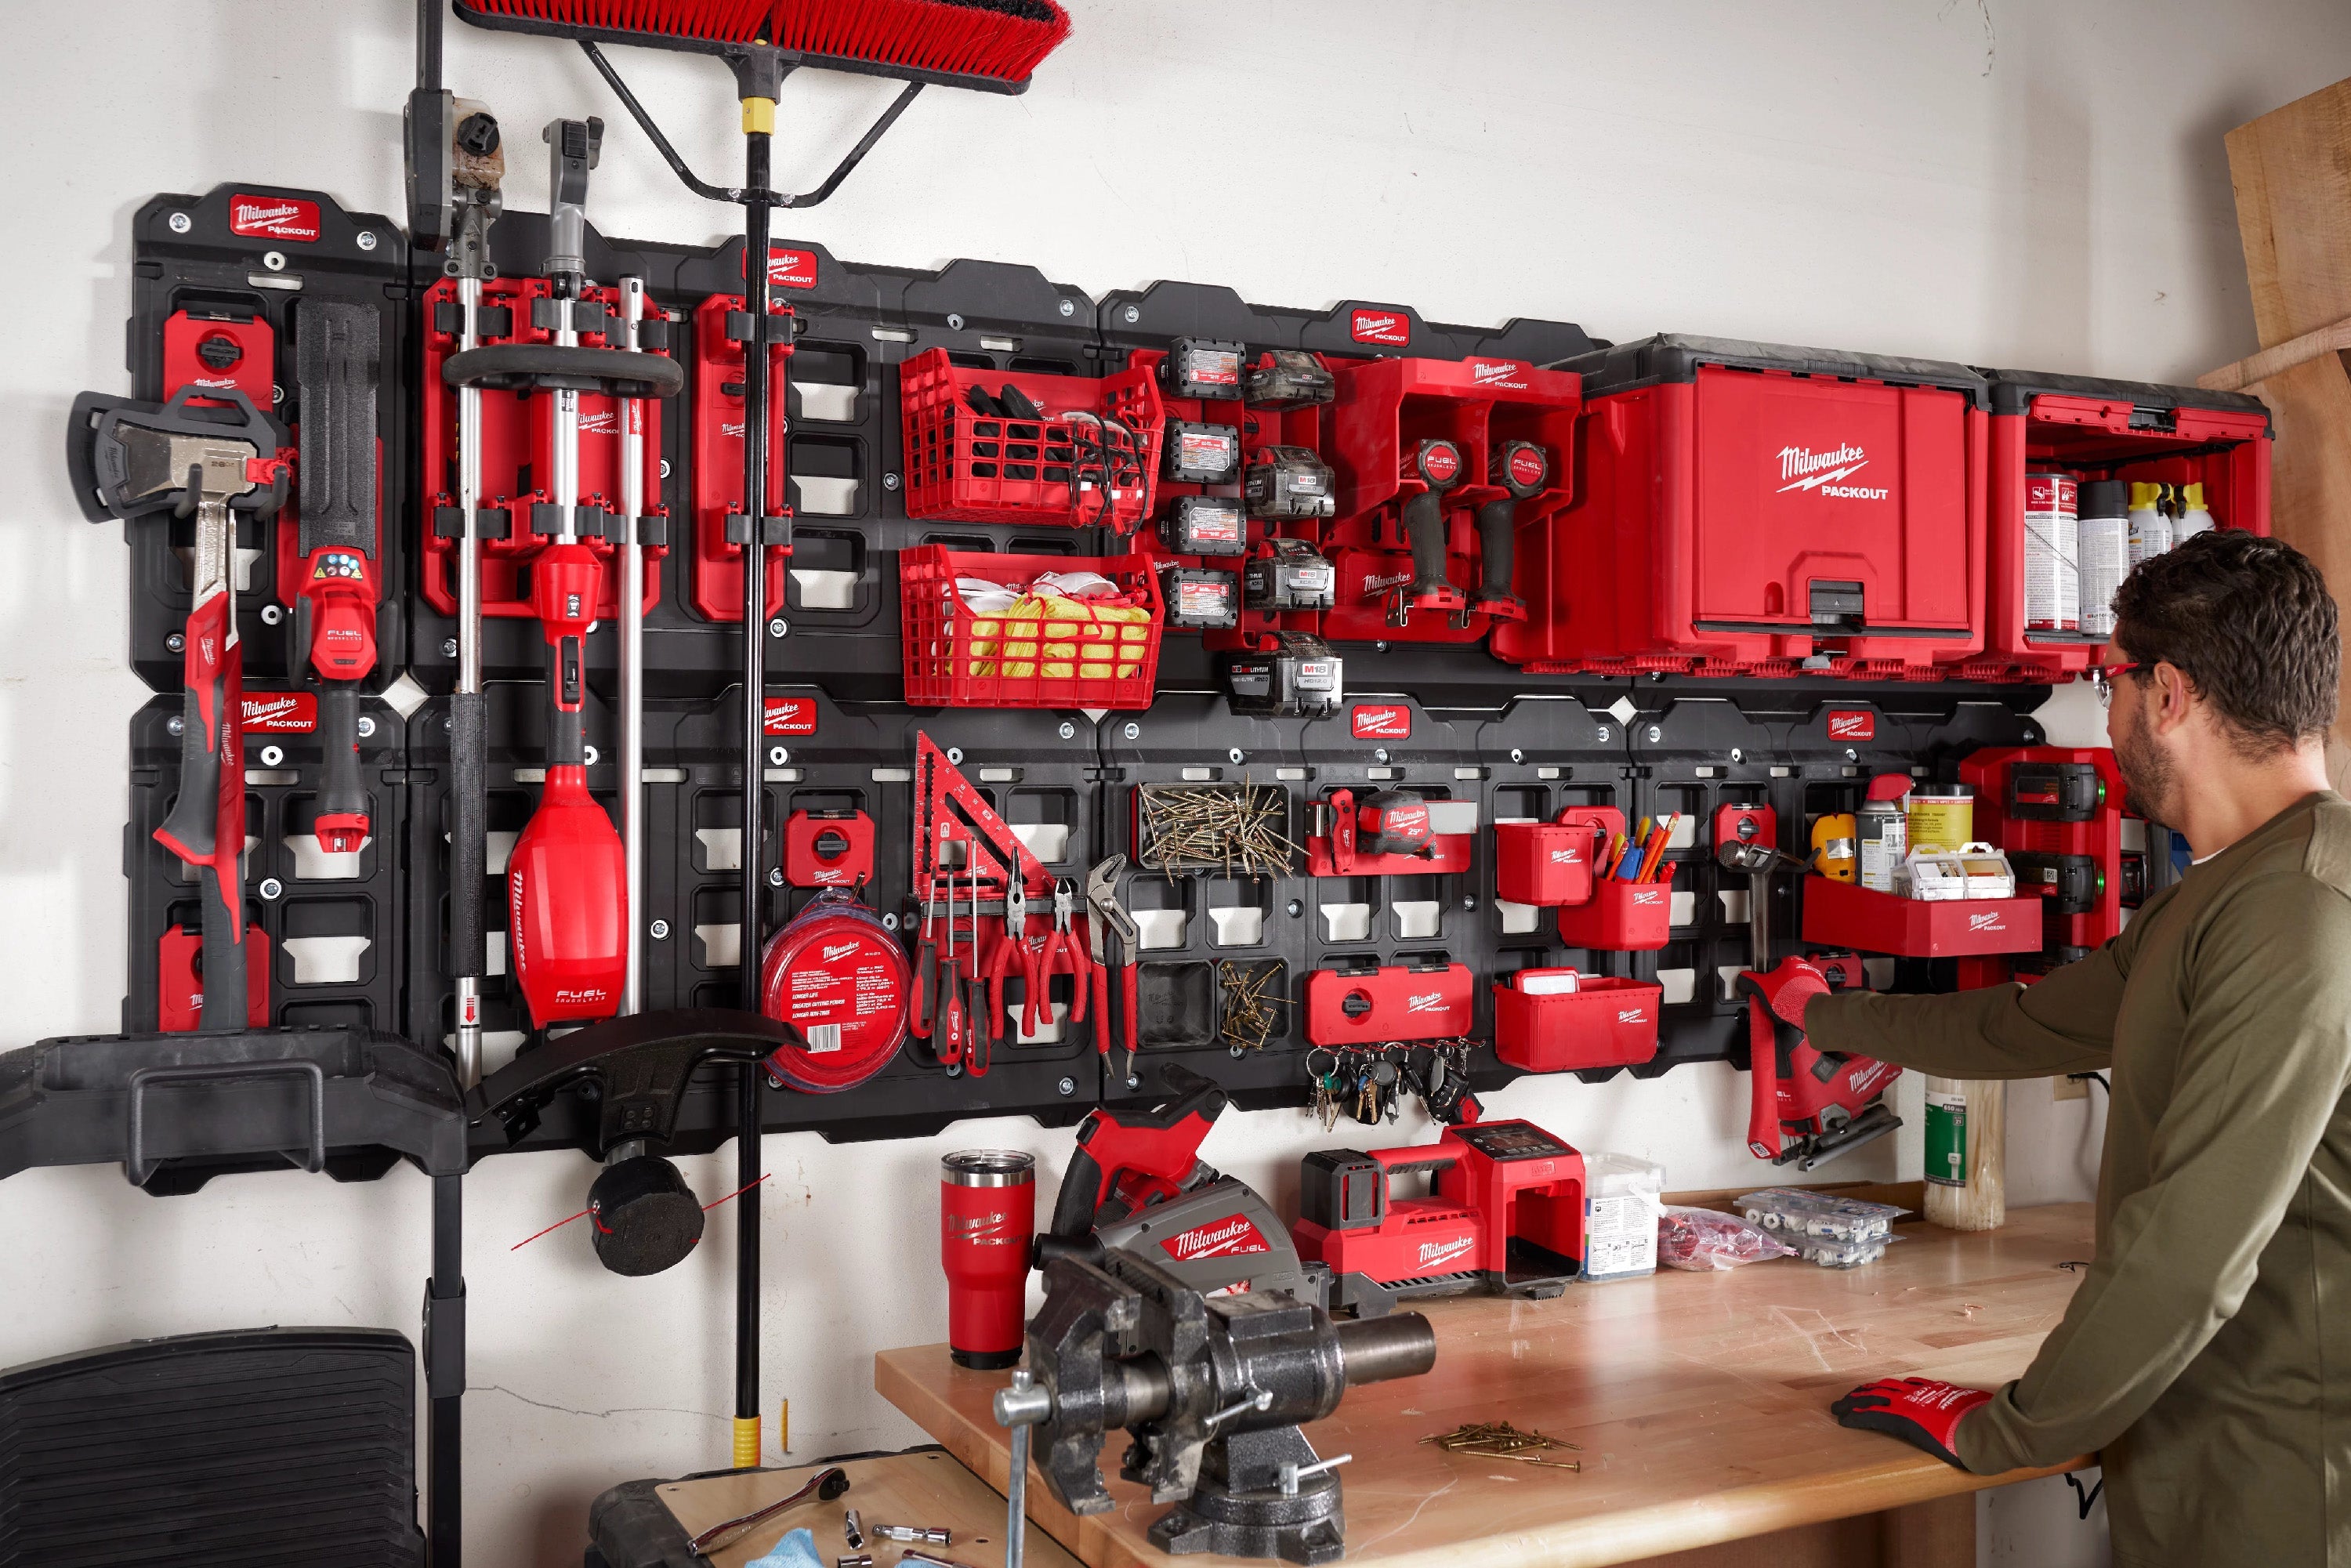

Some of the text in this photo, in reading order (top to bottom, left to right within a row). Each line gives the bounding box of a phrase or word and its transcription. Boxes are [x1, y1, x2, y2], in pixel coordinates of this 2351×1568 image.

[235, 204, 299, 223] Milwaukee
[268, 226, 316, 237] PACKOUT
[773, 273, 813, 284] PACKOUT
[1355, 316, 1396, 331] Milwaukee
[1375, 334, 1407, 342] PACKOUT
[1474, 362, 1517, 379] Milwaukee
[194, 378, 236, 388] Milwaukee
[1494, 381, 1528, 390] PACKOUT
[578, 411, 614, 424] ilwaukee
[1427, 455, 1456, 465] FUEL
[1513, 458, 1541, 470] FUEL
[1776, 442, 1864, 481] Milwaukee
[1821, 485, 1889, 500] PACKOUT
[1363, 572, 1411, 592] Milwaukee
[204, 638, 216, 666] Milwaukee
[1304, 665, 1327, 674] M18
[241, 697, 297, 718] Milwaukee
[266, 719, 313, 728] PACKOUT
[1355, 709, 1396, 726] Milwaukee
[1831, 715, 1864, 730] Milwaukee
[221, 722, 235, 766] Milwaukee
[1389, 809, 1426, 824] Milwaukee
[1551, 848, 1577, 860] Milwaukee
[813, 868, 842, 880] Milwaukee
[1633, 890, 1658, 902] Milwaukee
[513, 870, 527, 972] Milwaukee
[1969, 911, 1999, 925] Milwaukee
[821, 940, 860, 959] Milwaukee
[556, 989, 607, 998] FUEL
[1407, 991, 1442, 1008] Milwaukee
[1617, 1008, 1643, 1021] Milwaukee
[1849, 1059, 1886, 1092] Milwauk
[947, 1211, 1008, 1233] Milwaukee
[973, 1235, 1023, 1245] PACKOUT
[1176, 1219, 1252, 1258] Milwaukee
[1231, 1244, 1266, 1255] FUEL
[1418, 1235, 1473, 1262] Milwaukee
